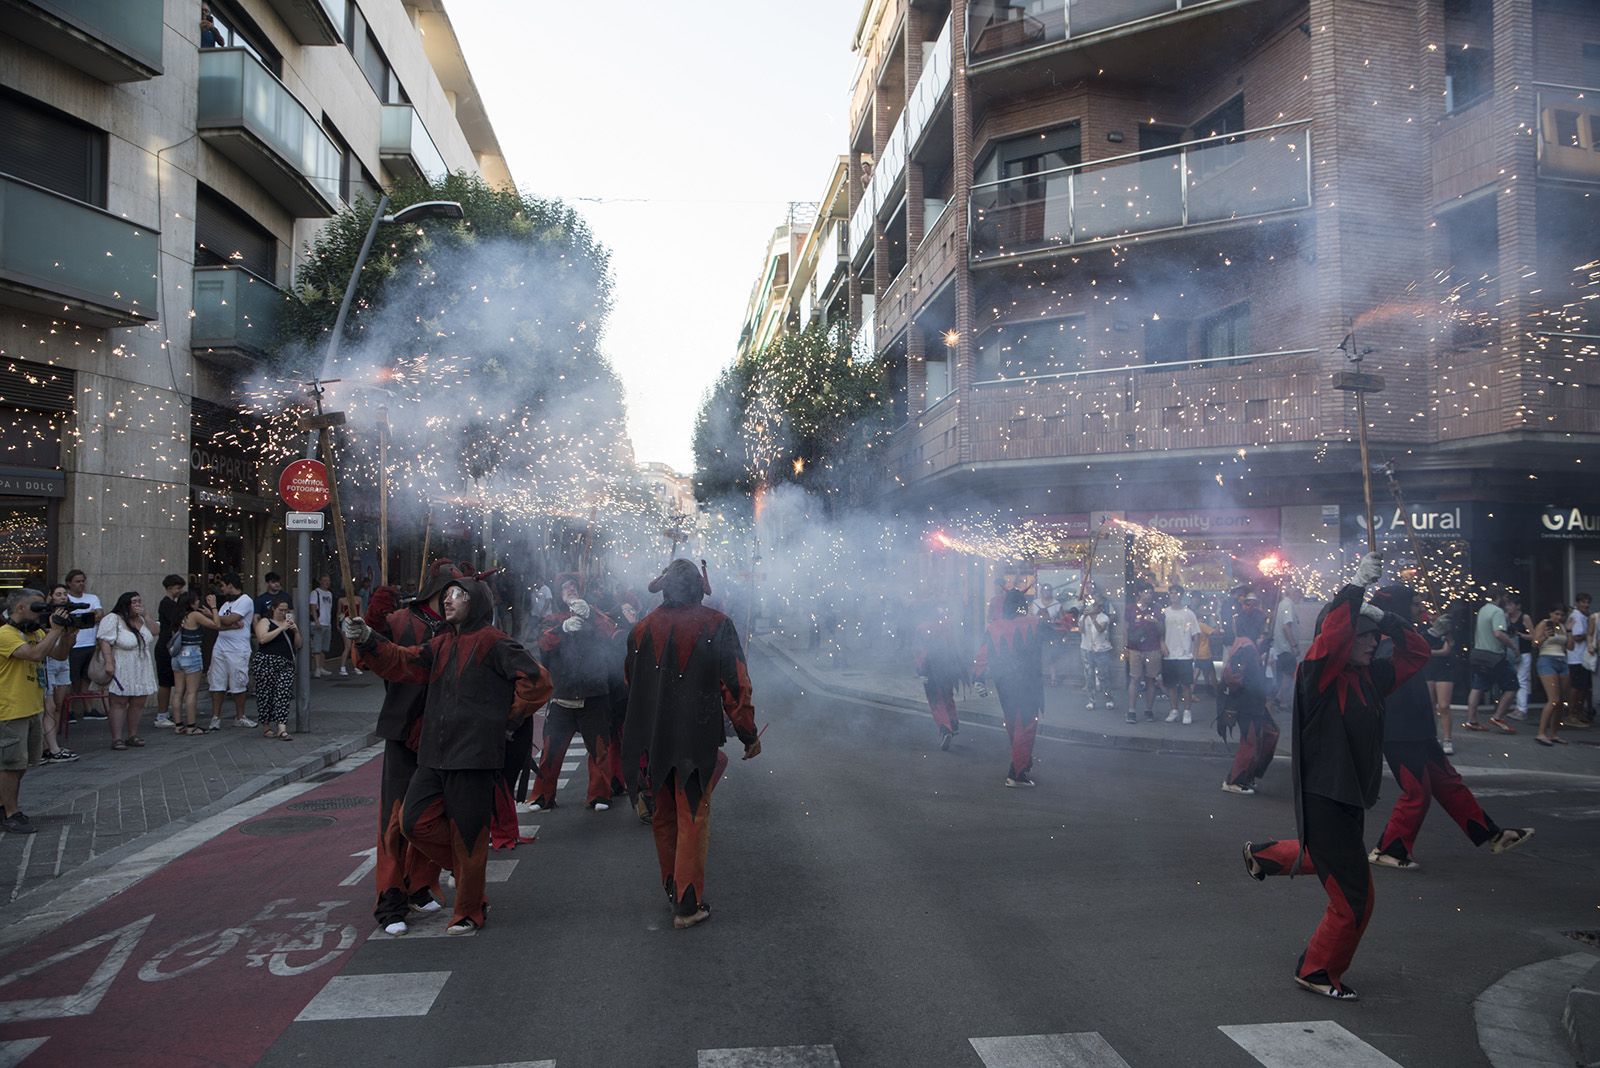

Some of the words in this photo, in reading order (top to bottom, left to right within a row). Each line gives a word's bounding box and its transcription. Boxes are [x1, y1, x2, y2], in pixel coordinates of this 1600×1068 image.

[25, 481, 54, 492] DOLÇ
[292, 478, 324, 486] CONTROL
[1148, 514, 1250, 531] dormity.com
[1390, 507, 1461, 531] Aural
